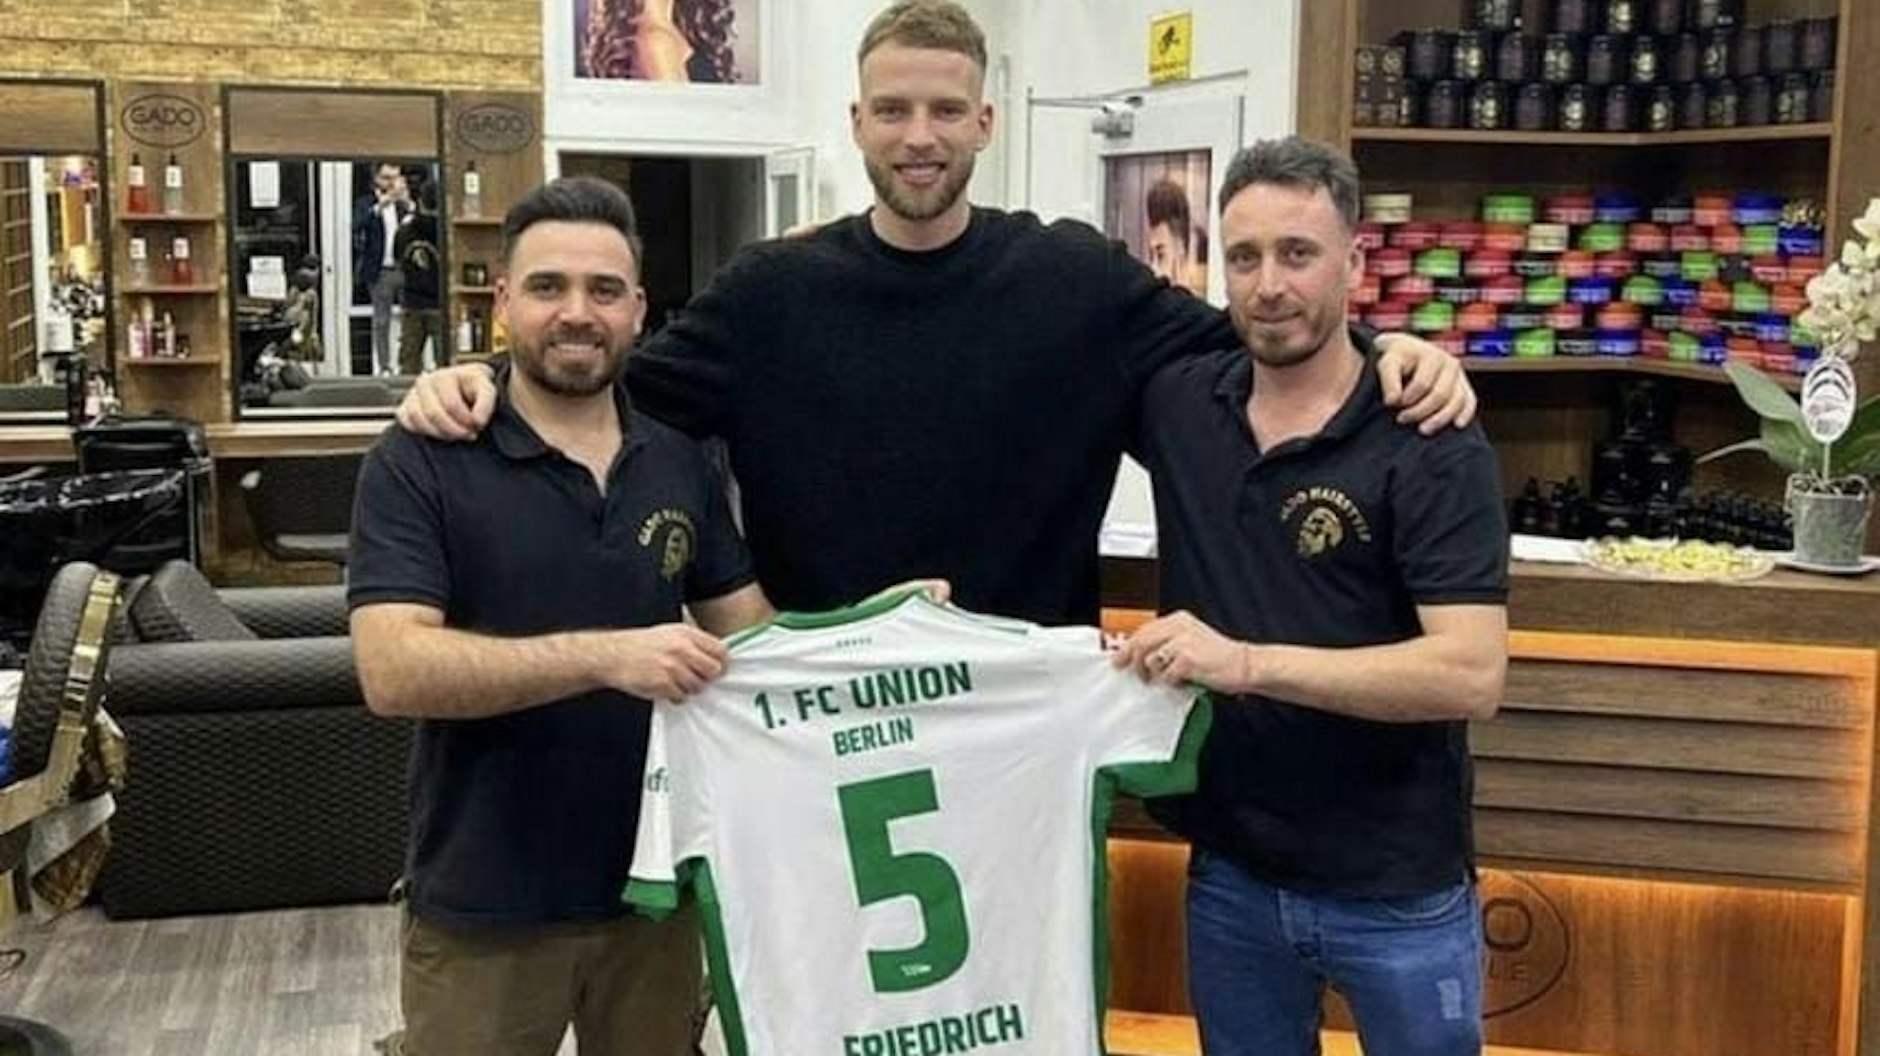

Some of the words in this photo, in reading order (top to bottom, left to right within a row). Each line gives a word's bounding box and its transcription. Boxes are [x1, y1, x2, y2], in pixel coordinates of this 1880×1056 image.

[130, 105, 195, 125] GADO
[464, 113, 526, 132] GADO
[755, 691, 786, 729] 1.
[794, 685, 841, 721] FC
[850, 661, 973, 711] UNION
[833, 717, 915, 756] BERLIN
[837, 768, 970, 993] 5
[843, 1003, 1023, 1056] FRIEDRICH
